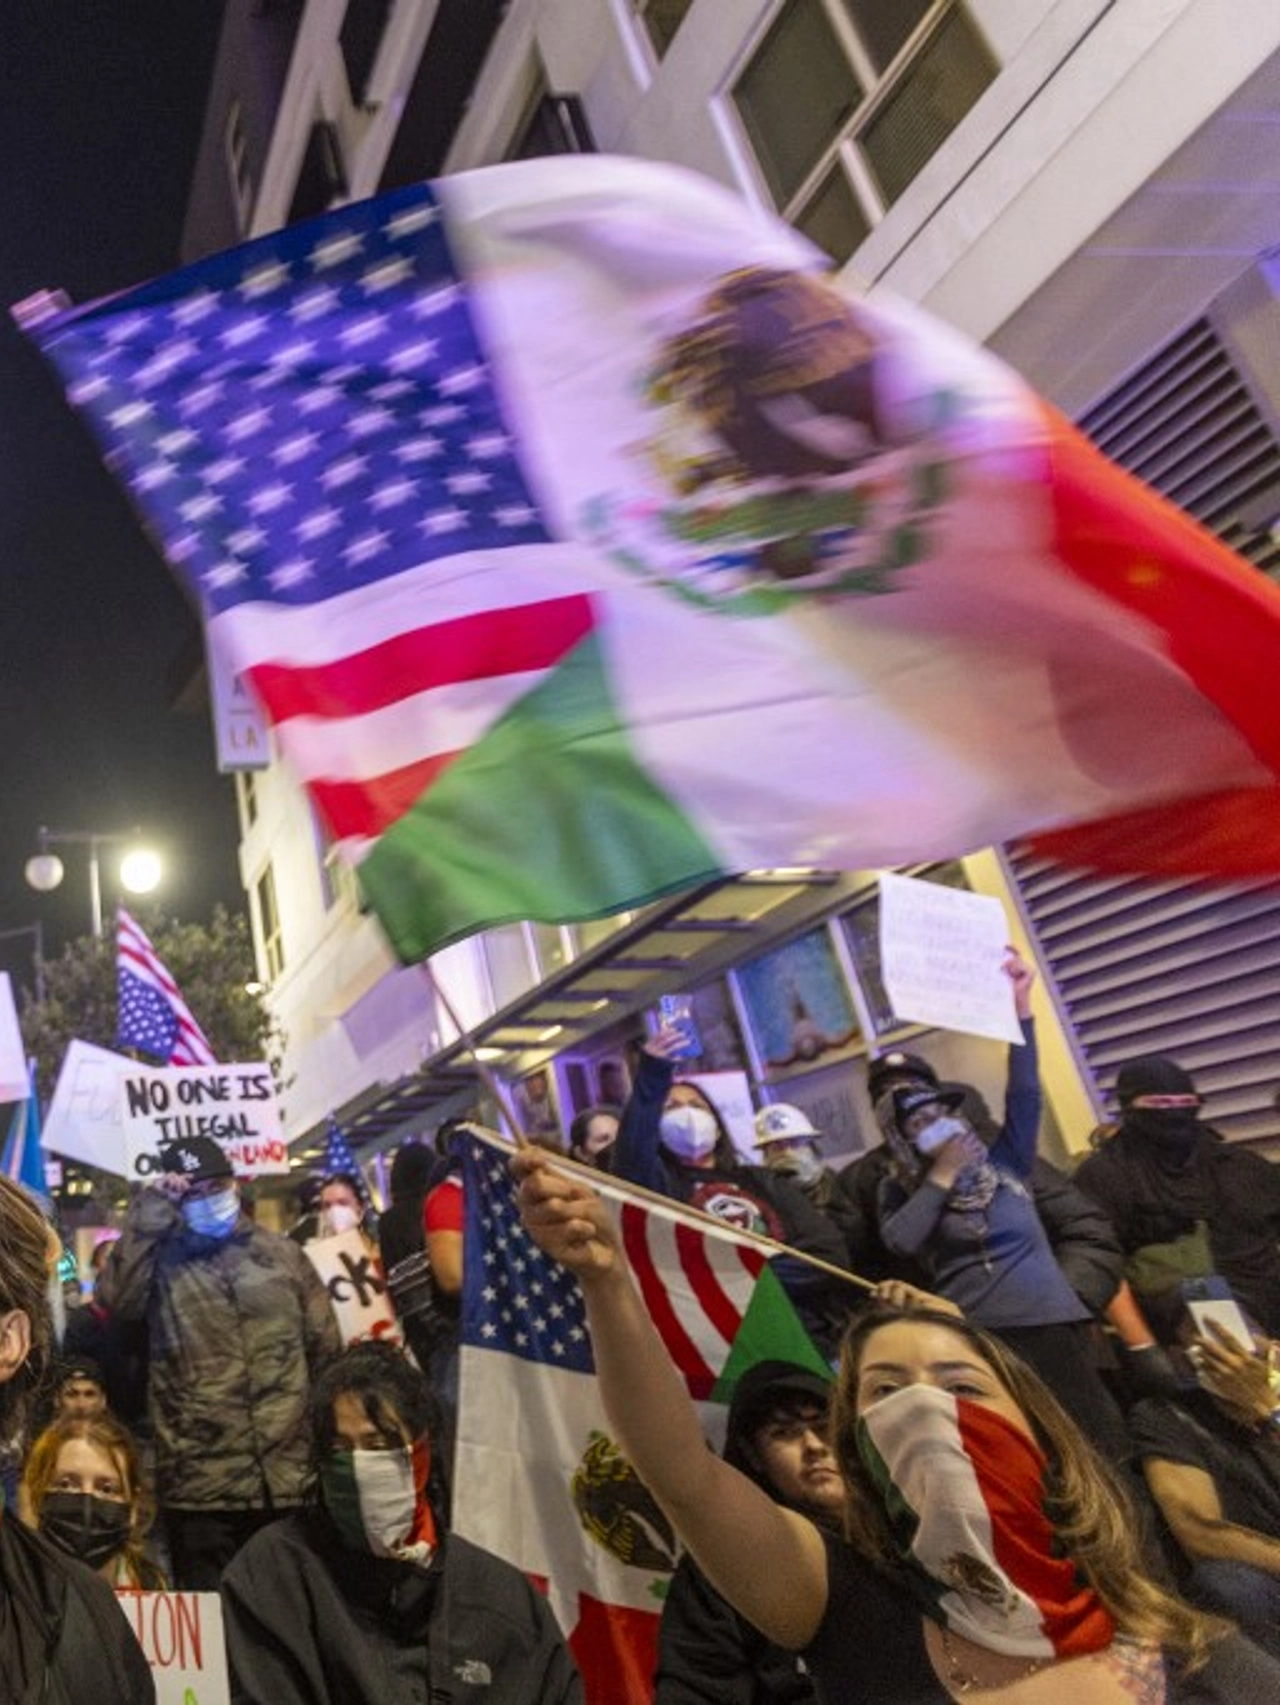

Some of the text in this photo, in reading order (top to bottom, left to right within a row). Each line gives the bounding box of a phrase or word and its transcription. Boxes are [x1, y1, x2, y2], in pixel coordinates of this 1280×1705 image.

[126, 1075, 270, 1118] NO ONE IS
[155, 1113, 259, 1147] ILLEGAL
